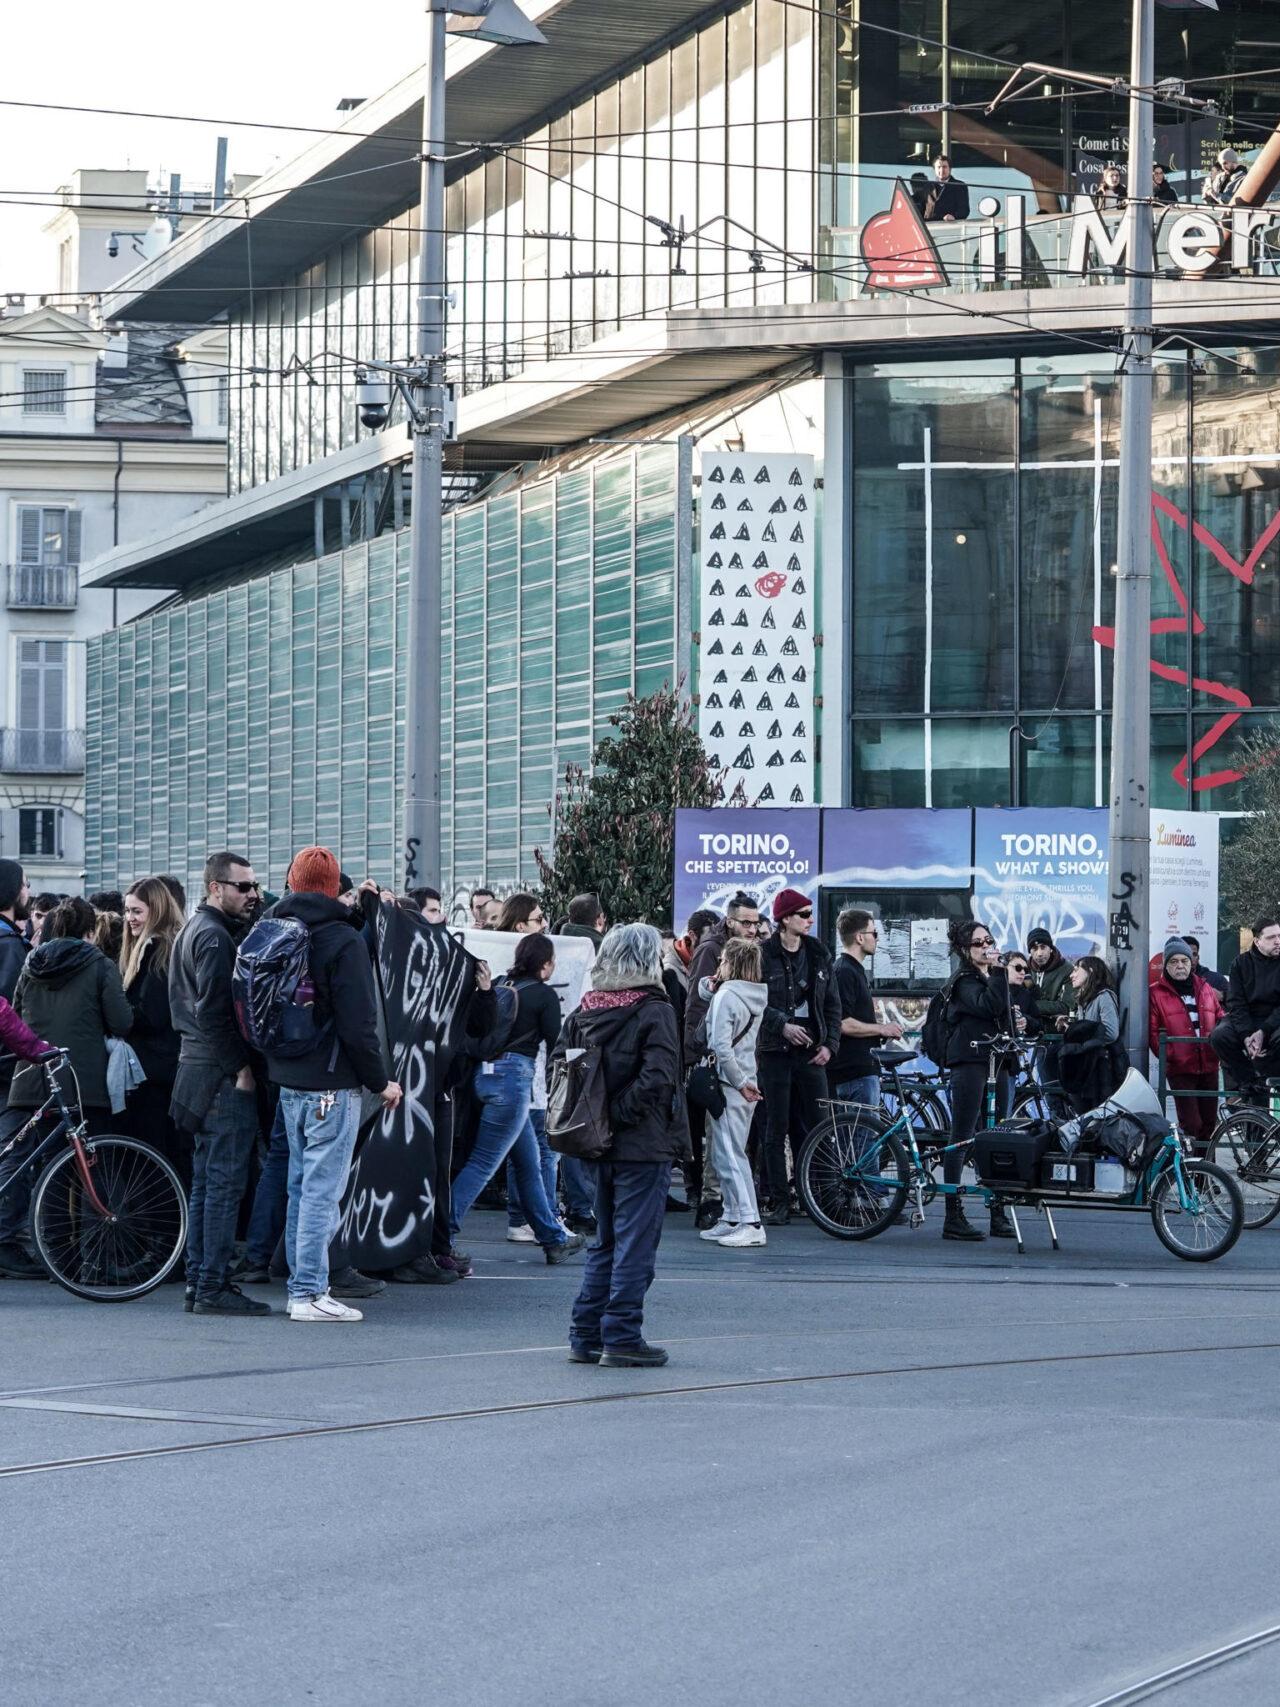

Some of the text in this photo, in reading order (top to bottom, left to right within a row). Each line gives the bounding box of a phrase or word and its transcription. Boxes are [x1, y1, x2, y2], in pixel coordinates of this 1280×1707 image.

[1079, 136, 1109, 151] Come
[1111, 137, 1119, 151] ti
[1201, 140, 1231, 148] Scriilo
[1079, 160, 1104, 174] Cosa
[978, 196, 1024, 283] il
[699, 834, 796, 859] TORINO,
[1001, 834, 1104, 859] TORINO,
[685, 860, 809, 874] CHE SPETTACOLO!
[996, 861, 1109, 875] WHAT A SHOW!
